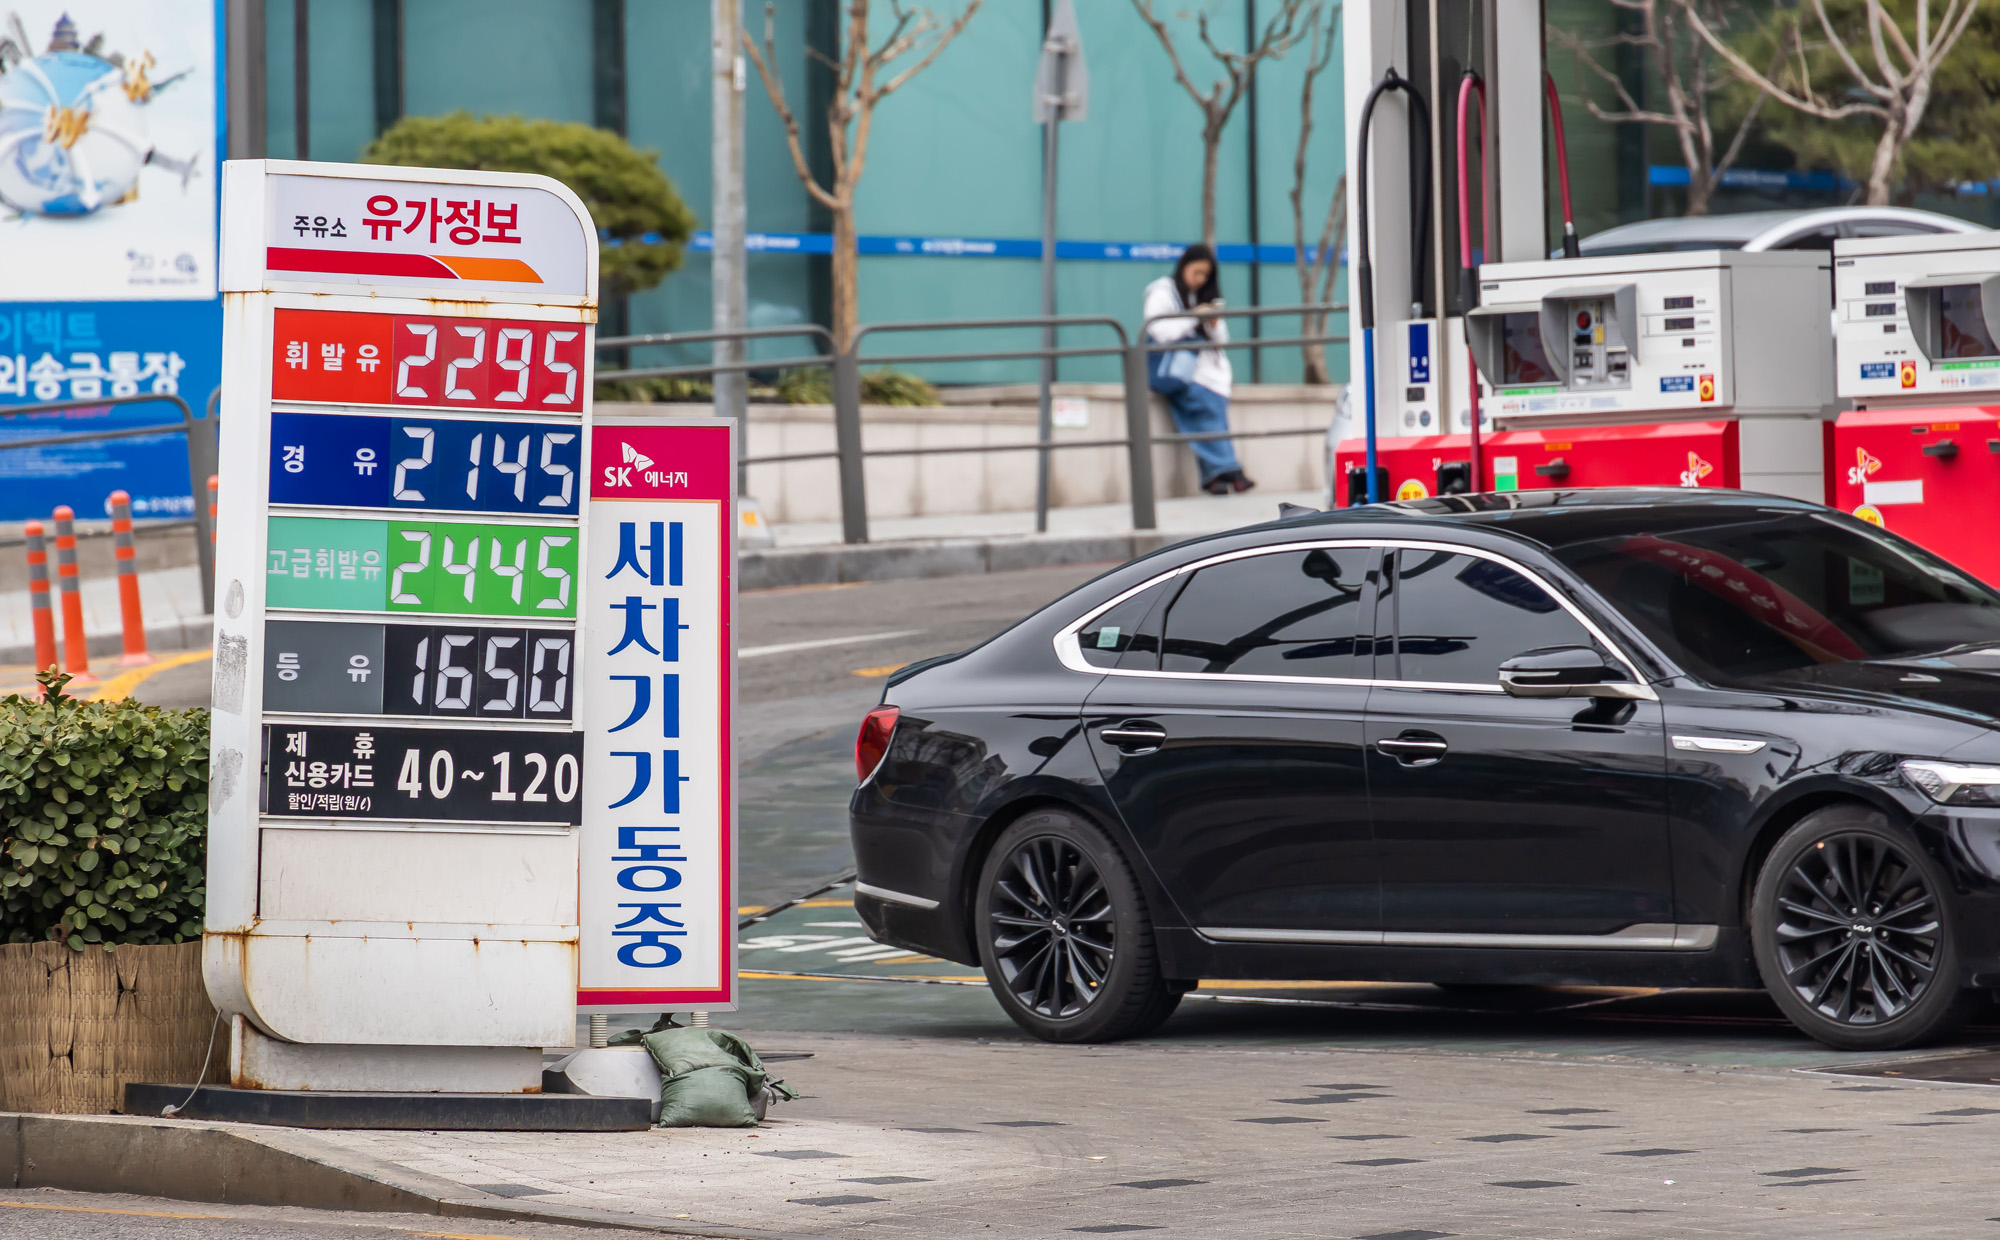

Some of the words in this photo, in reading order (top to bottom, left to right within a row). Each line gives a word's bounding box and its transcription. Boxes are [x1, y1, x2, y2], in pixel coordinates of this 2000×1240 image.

[293, 215, 347, 238] 주유소
[362, 195, 521, 246] 유가정보
[396, 323, 579, 405] 2295
[393, 426, 576, 507] 2145
[604, 466, 632, 488] SK
[644, 470, 688, 489] 에너지
[1680, 470, 1698, 487] SK
[1848, 466, 1867, 485] SK
[267, 547, 382, 580] 고급휘발유
[390, 530, 573, 609] 2445
[412, 634, 571, 712] 1650
[284, 761, 375, 789] 신용카드
[604, 521, 690, 969] 세차기가동중
